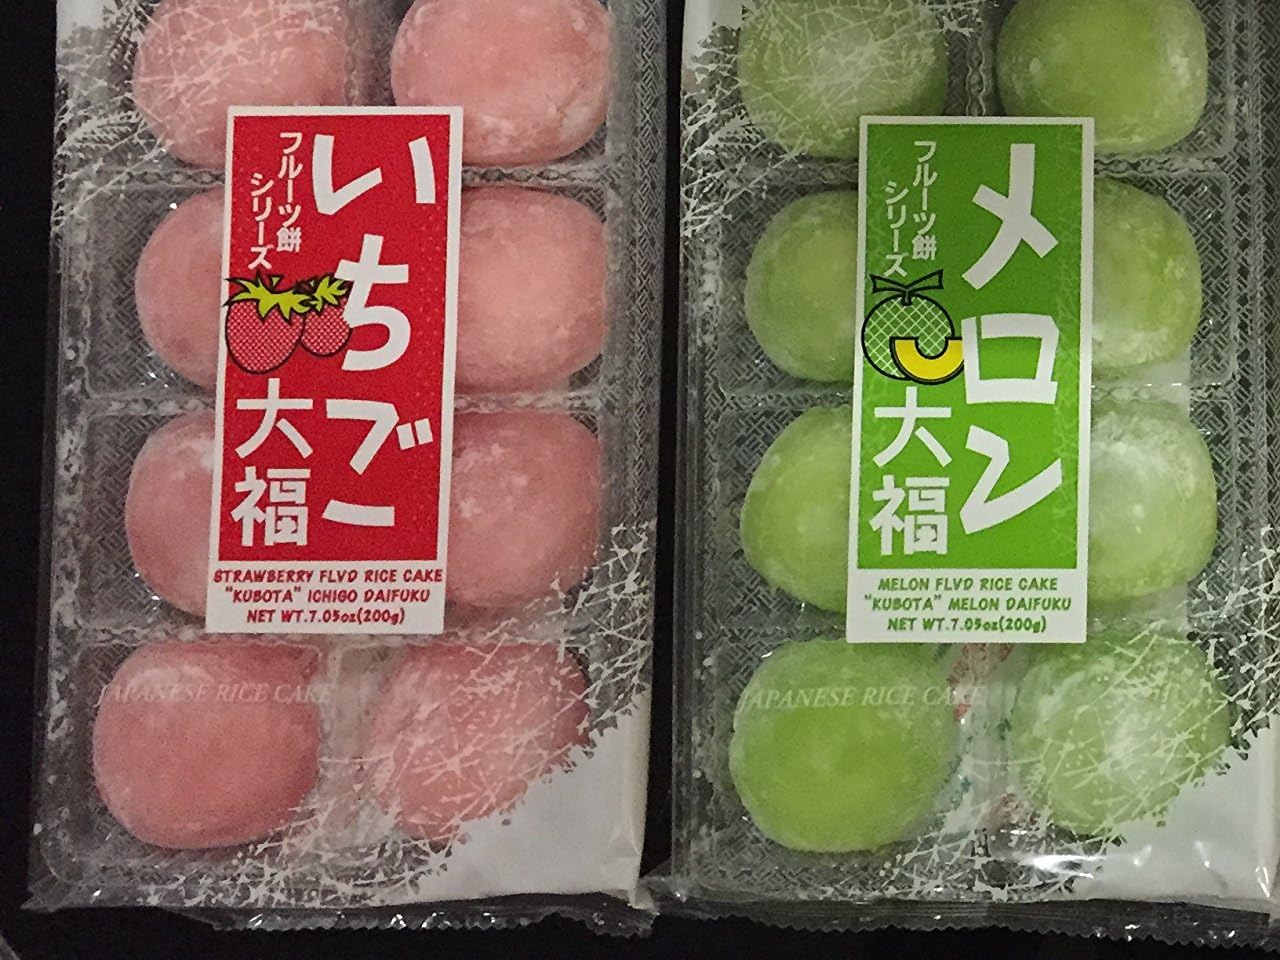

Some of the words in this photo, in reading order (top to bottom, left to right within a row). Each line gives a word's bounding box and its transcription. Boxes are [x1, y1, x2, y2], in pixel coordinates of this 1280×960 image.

[248, 172, 274, 270] シリーズ
[883, 180, 909, 277] シリーズ
[959, 143, 1063, 535] メロン
[231, 377, 314, 548] 大福
[868, 387, 952, 556] 大福
[213, 569, 313, 583] STRAWBERRY
[319, 569, 358, 583] FLVD
[364, 569, 399, 583] RICE
[403, 569, 443, 582] CAKE
[878, 577, 930, 591] MELON
[935, 577, 974, 591] FLVD
[980, 577, 1013, 591] RICE
[1018, 577, 1058, 591] CAKE
[307, 589, 358, 603] ICHIGO
[363, 589, 431, 603] DAIFUKU
[948, 597, 999, 611] MELON
[1006, 597, 1072, 611] DAIFUKU
[246, 609, 276, 623] NET
[887, 617, 917, 631] NET
[738, 687, 854, 712] JAPANESE
[861, 685, 917, 706] RICE
[921, 686, 989, 706] CAKE
